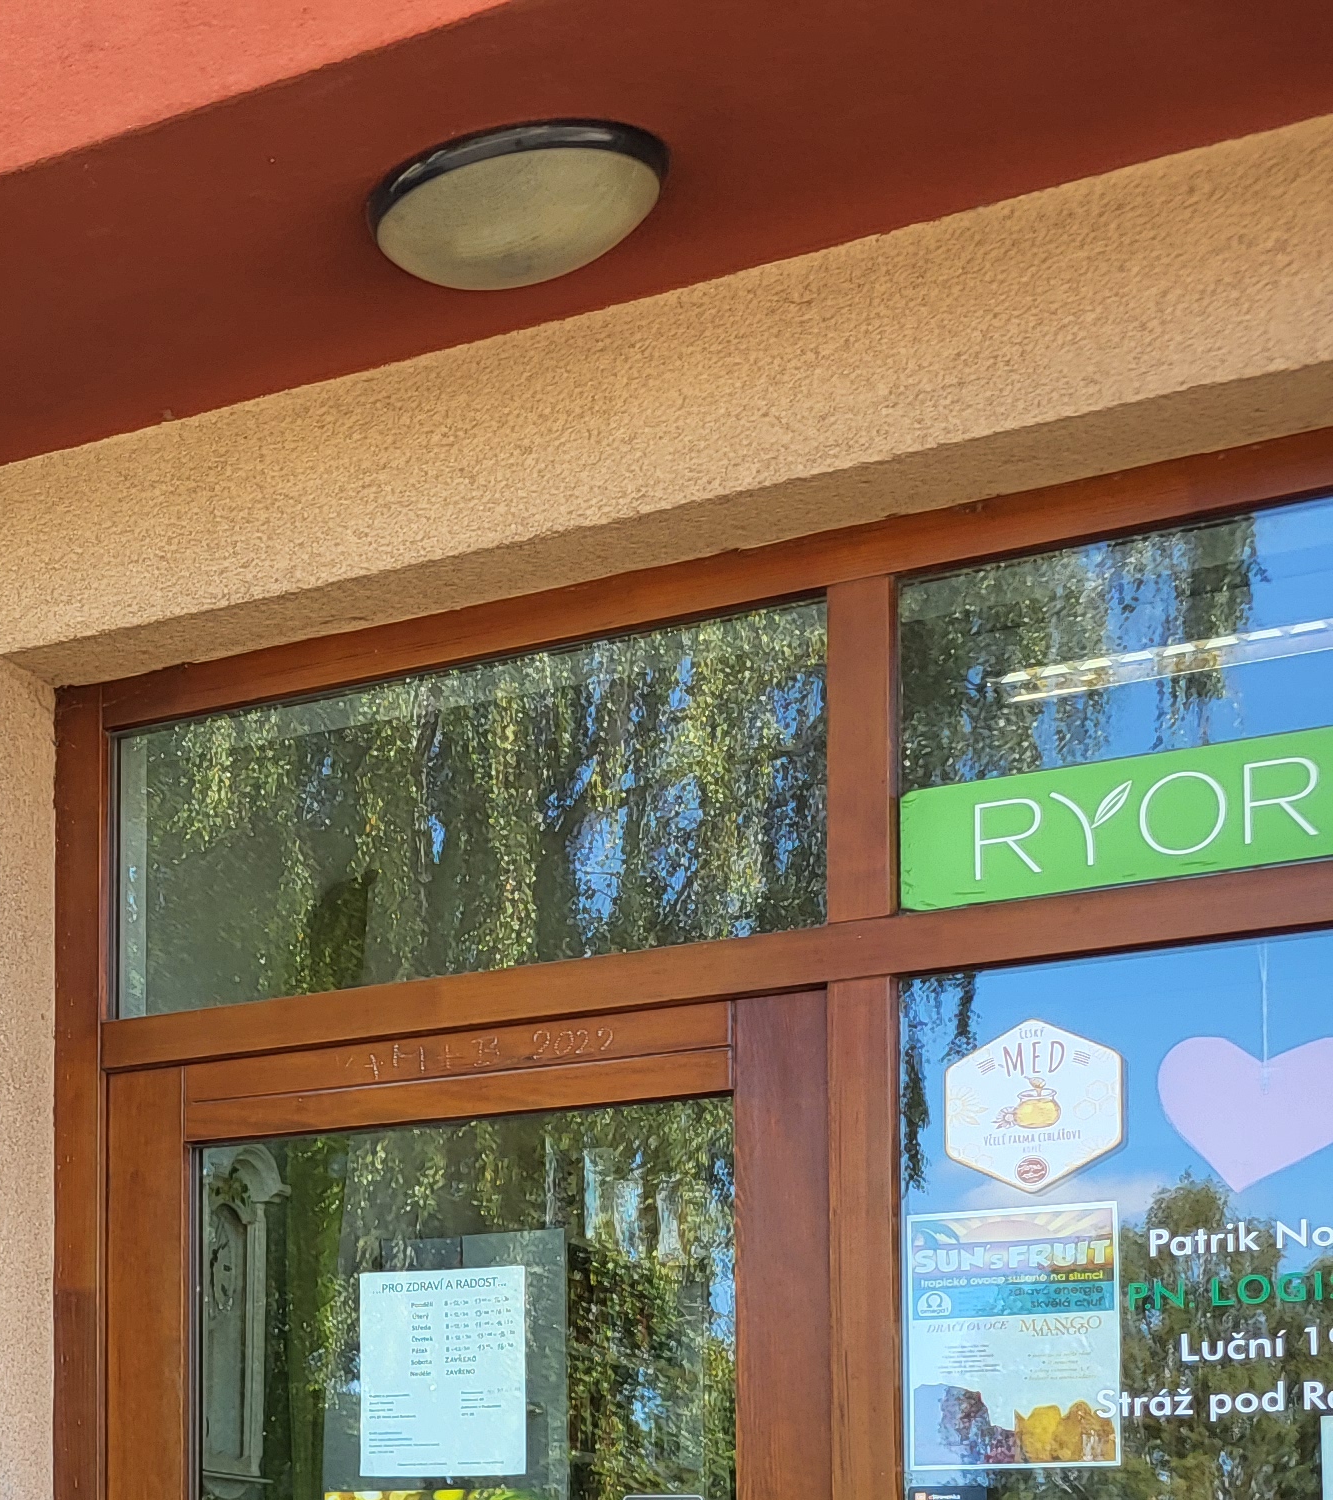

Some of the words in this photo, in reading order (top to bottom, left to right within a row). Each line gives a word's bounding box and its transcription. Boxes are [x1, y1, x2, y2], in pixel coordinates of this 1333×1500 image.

[973, 755, 1319, 881] RYOR
[1018, 1027, 1046, 1040] ČESKÝ
[1002, 1040, 1065, 1077] MED
[1008, 1133, 1036, 1144] FARMA
[1149, 1221, 1261, 1257] Patrik
[1008, 1239, 1111, 1273] FRUIT
[406, 1278, 443, 1292] ZDRAVÍ
[445, 1280, 454, 1290] A
[921, 1275, 967, 1288] tropické
[970, 1276, 1005, 1285] ovoce
[1050, 1273, 1066, 1281] na
[1069, 1270, 1104, 1280] slunci
[1054, 1284, 1104, 1296] energie
[1127, 1281, 1195, 1310] P.N.
[1211, 1271, 1333, 1307] LOGI
[1030, 1297, 1071, 1309] skvělá
[1019, 1315, 1102, 1333] MANGO
[1180, 1329, 1287, 1362] Luční
[1096, 1387, 1194, 1419] Stráž
[1209, 1380, 1285, 1422] pod
